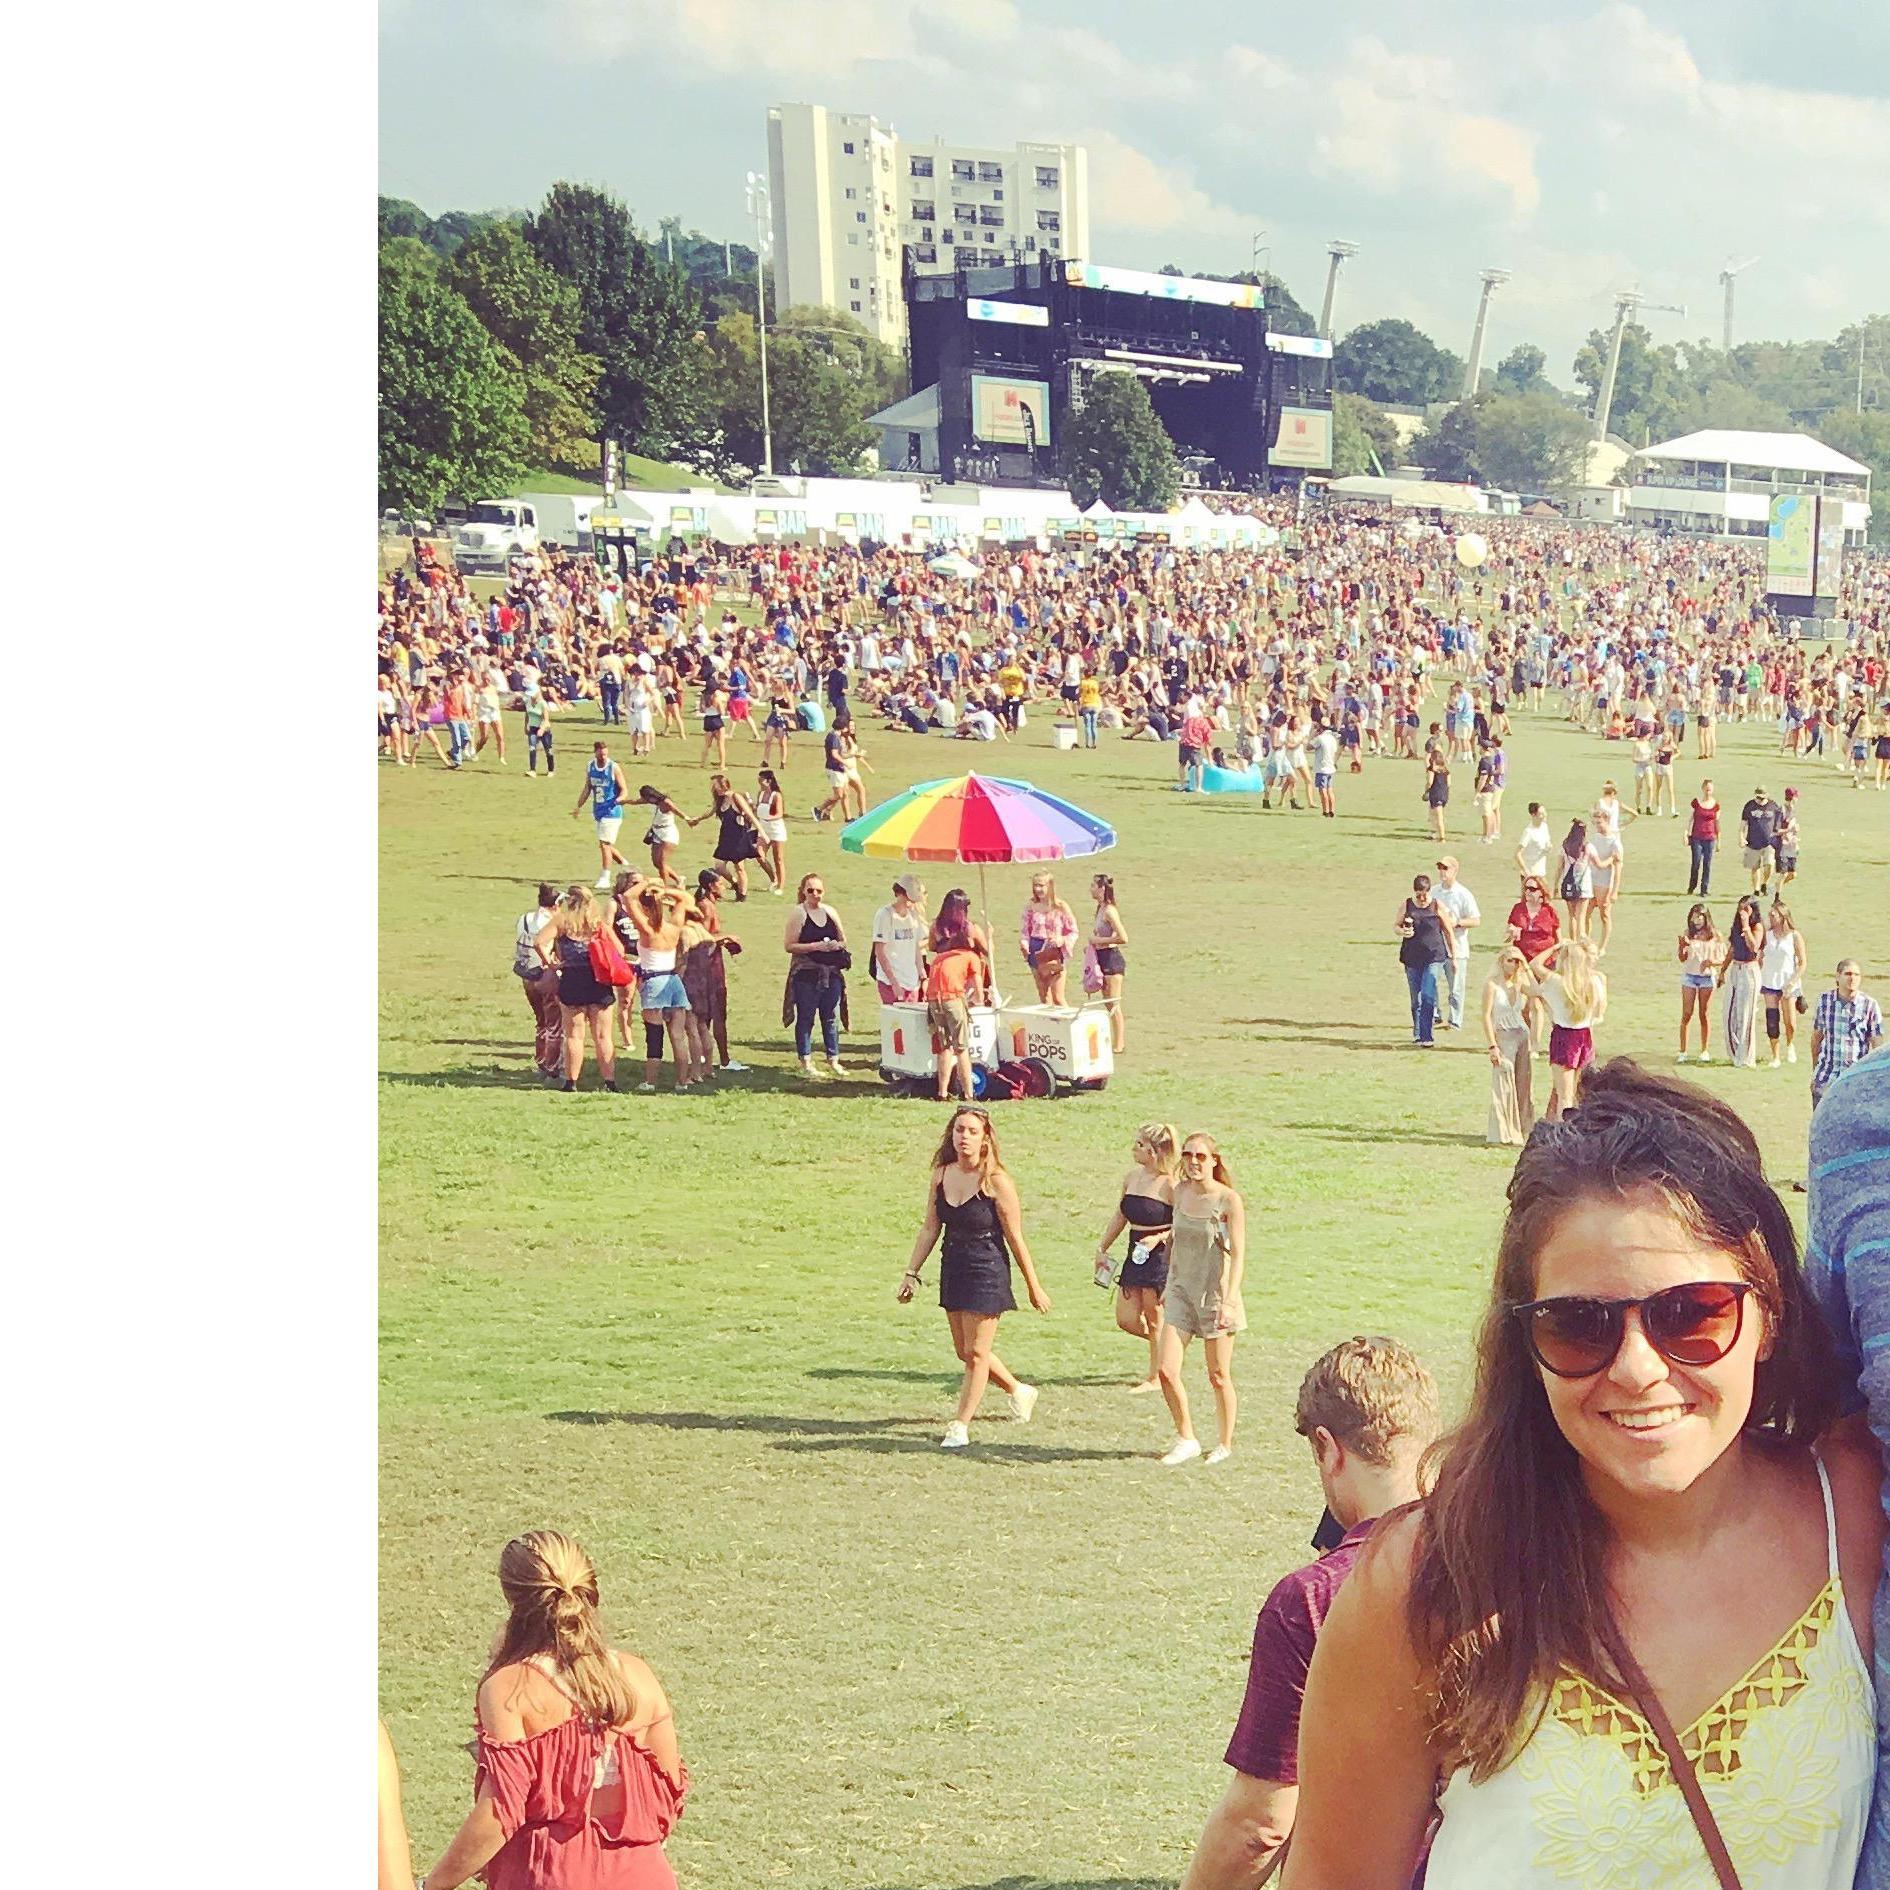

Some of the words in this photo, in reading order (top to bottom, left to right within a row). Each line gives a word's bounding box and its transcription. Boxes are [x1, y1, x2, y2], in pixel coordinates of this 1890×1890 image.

[777, 510, 807, 535] BAR
[856, 513, 884, 538] BAR
[932, 516, 957, 539] BAR
[1028, 1033, 1052, 1045] KING
[1028, 1043, 1067, 1061] POPS
